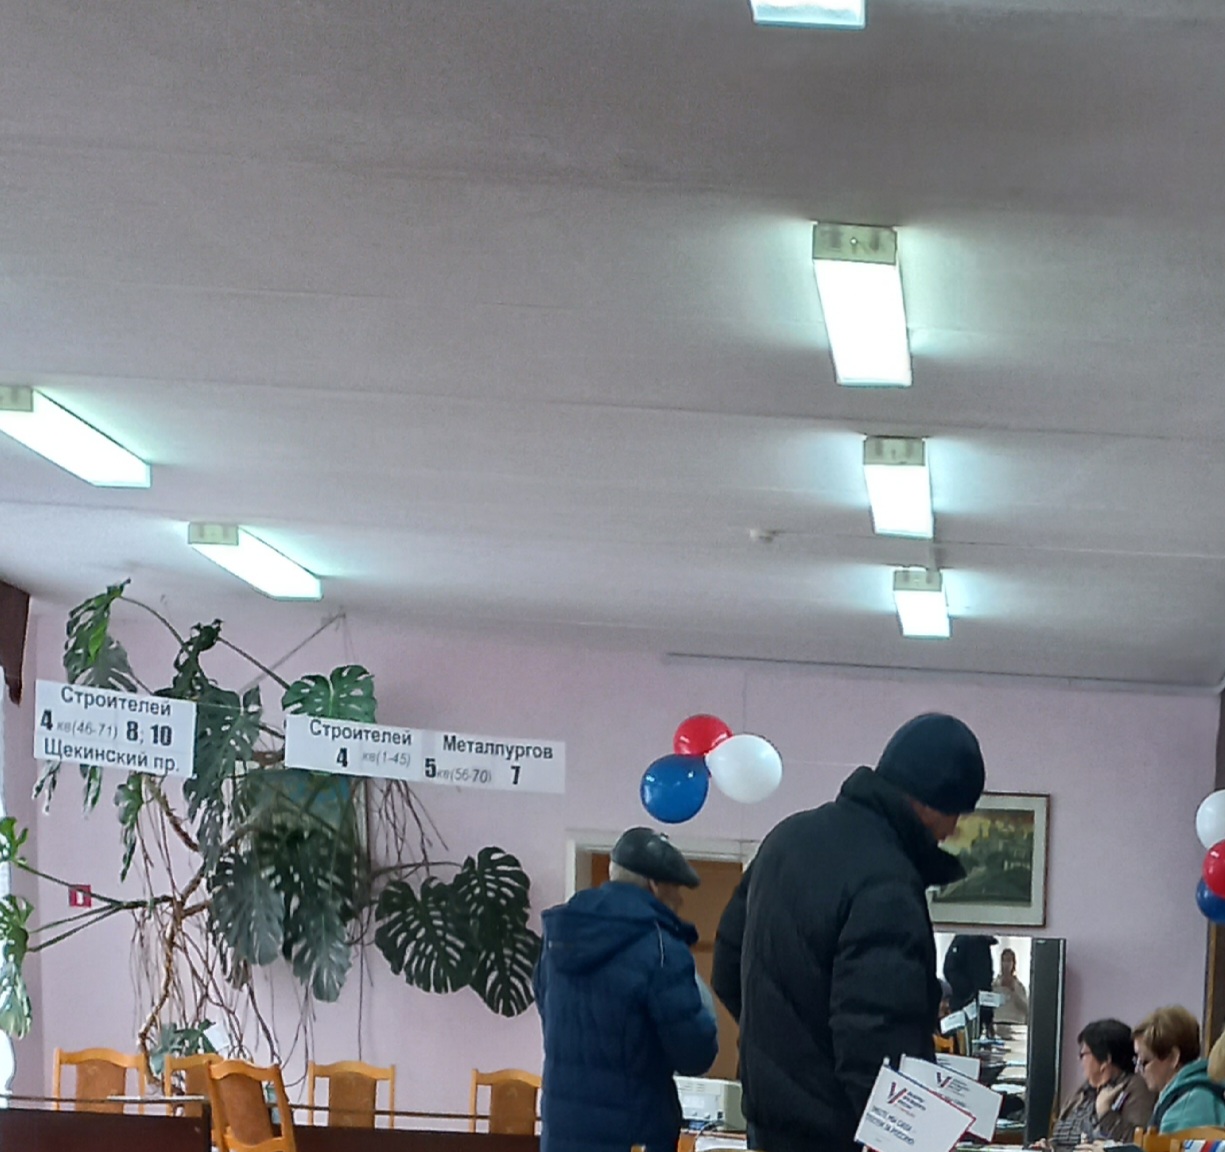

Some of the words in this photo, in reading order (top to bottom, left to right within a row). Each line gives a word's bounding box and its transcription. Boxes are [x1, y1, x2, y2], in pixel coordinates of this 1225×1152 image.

[61, 686, 171, 716] Строителей
[40, 709, 53, 731] 4
[151, 724, 172, 746] 10
[309, 719, 412, 746] Строителей
[44, 737, 148, 767] Щекинский
[154, 759, 179, 773] пр.
[336, 747, 348, 768] 4
[443, 734, 553, 761] Металлургов
[424, 758, 437, 778] 5
[510, 765, 521, 785] 7
